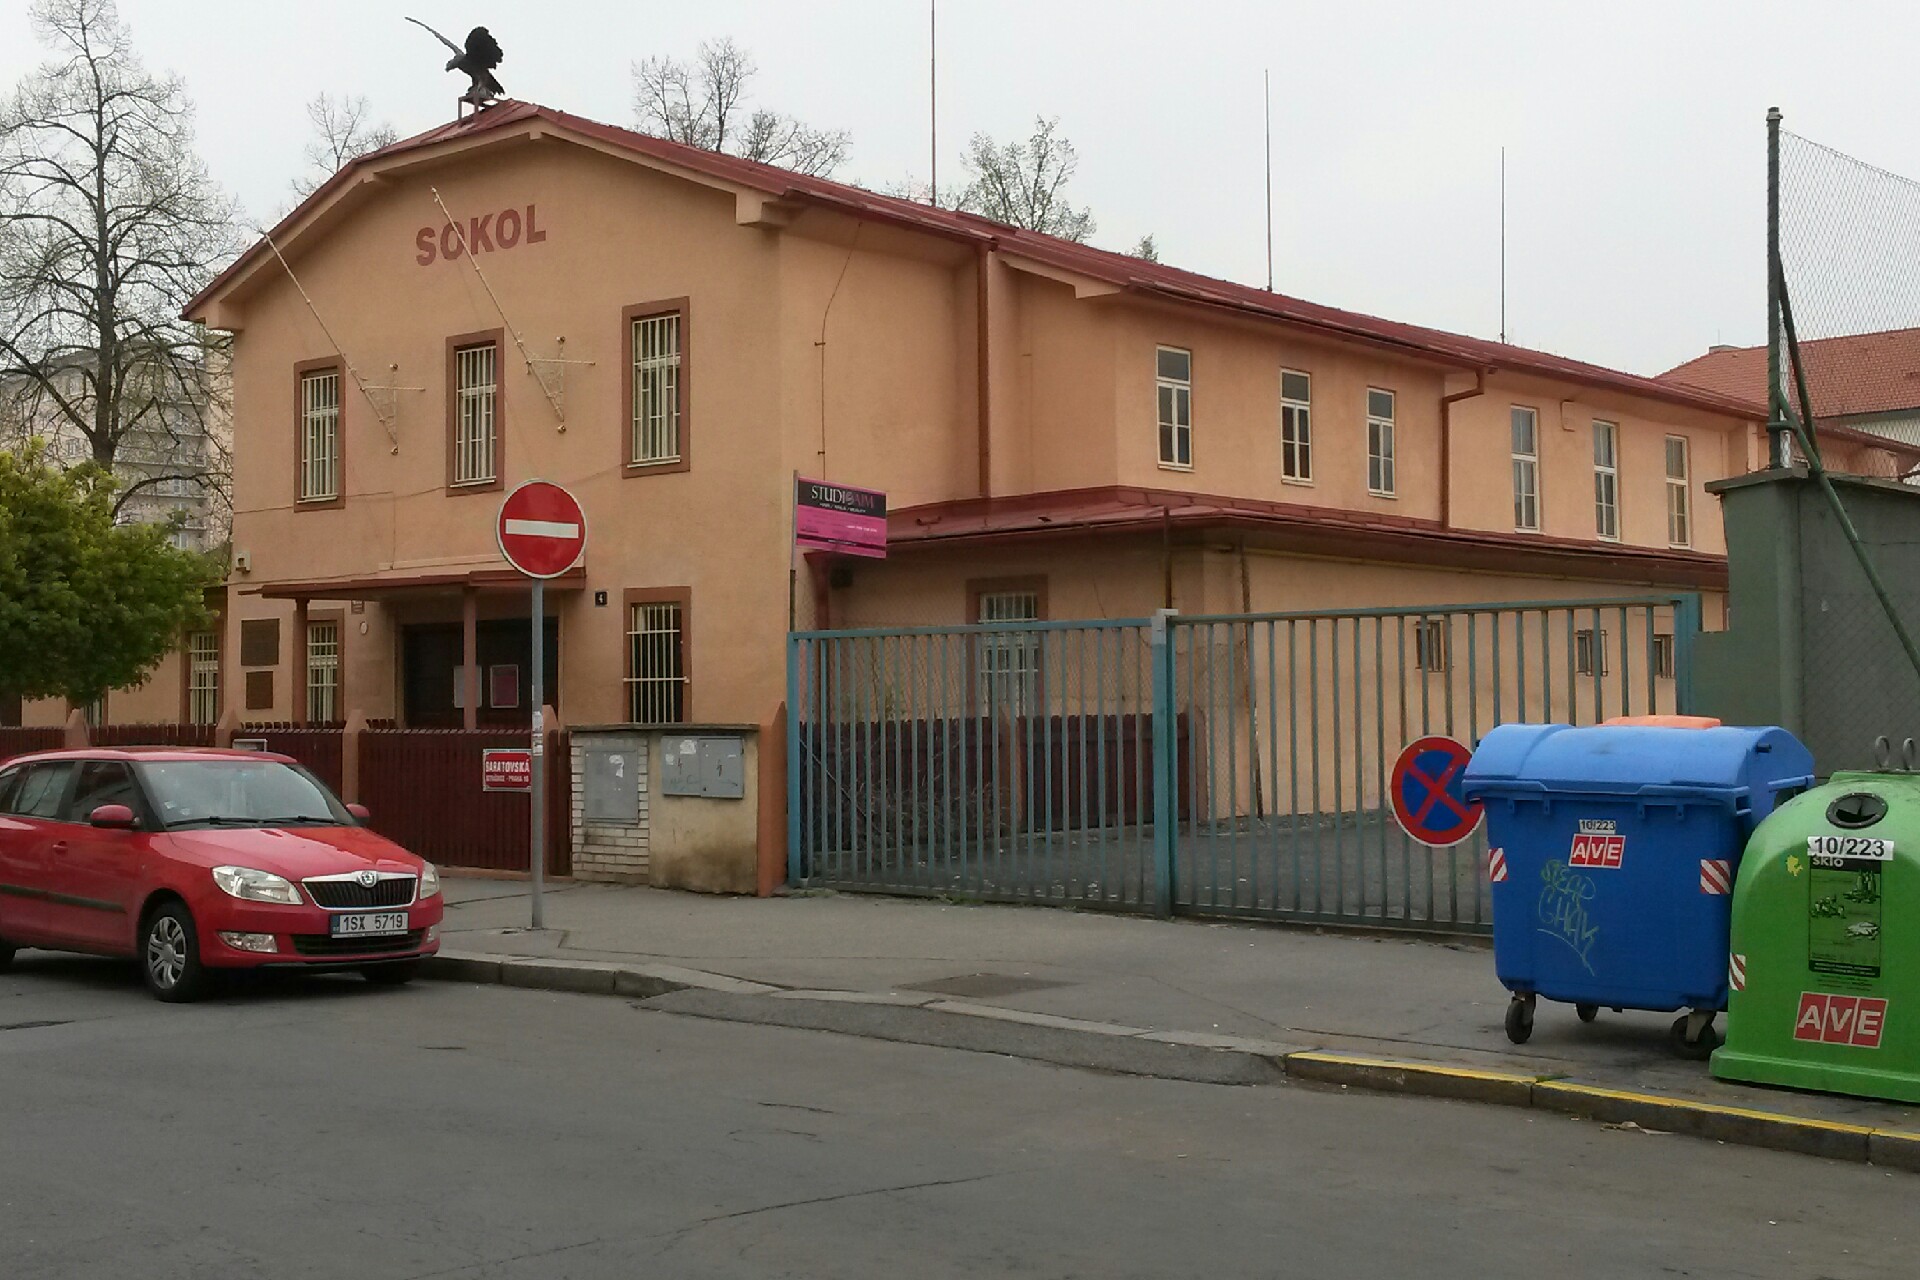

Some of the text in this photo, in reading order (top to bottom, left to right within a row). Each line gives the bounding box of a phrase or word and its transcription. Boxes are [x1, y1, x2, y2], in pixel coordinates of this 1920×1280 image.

[415, 203, 547, 267] SOKOL
[1581, 820, 1616, 831] 10/223
[1572, 842, 1621, 860] AVE
[1814, 836, 1885, 858] 10/223
[343, 914, 403, 931] 1SX 5719
[1797, 1004, 1882, 1037] AVE
